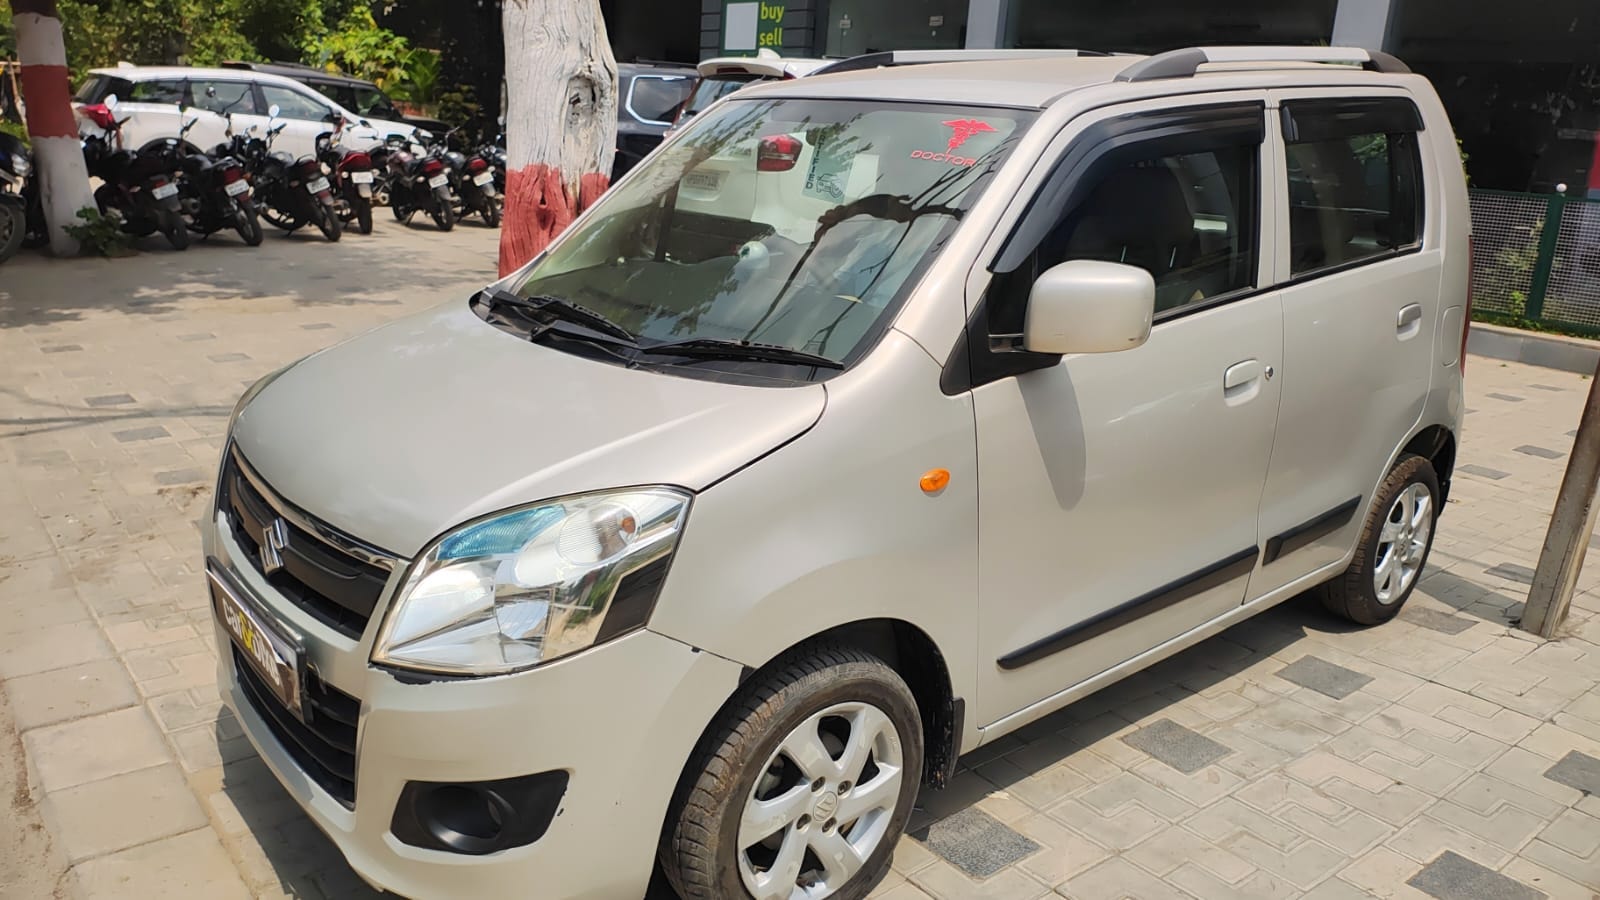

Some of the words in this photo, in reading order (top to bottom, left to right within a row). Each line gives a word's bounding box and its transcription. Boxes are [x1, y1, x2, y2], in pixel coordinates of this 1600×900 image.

[761, 2, 784, 22] buy
[760, 27, 782, 45] sell
[806, 127, 827, 189] RTIFIED
[911, 149, 976, 167] DOCTOR
